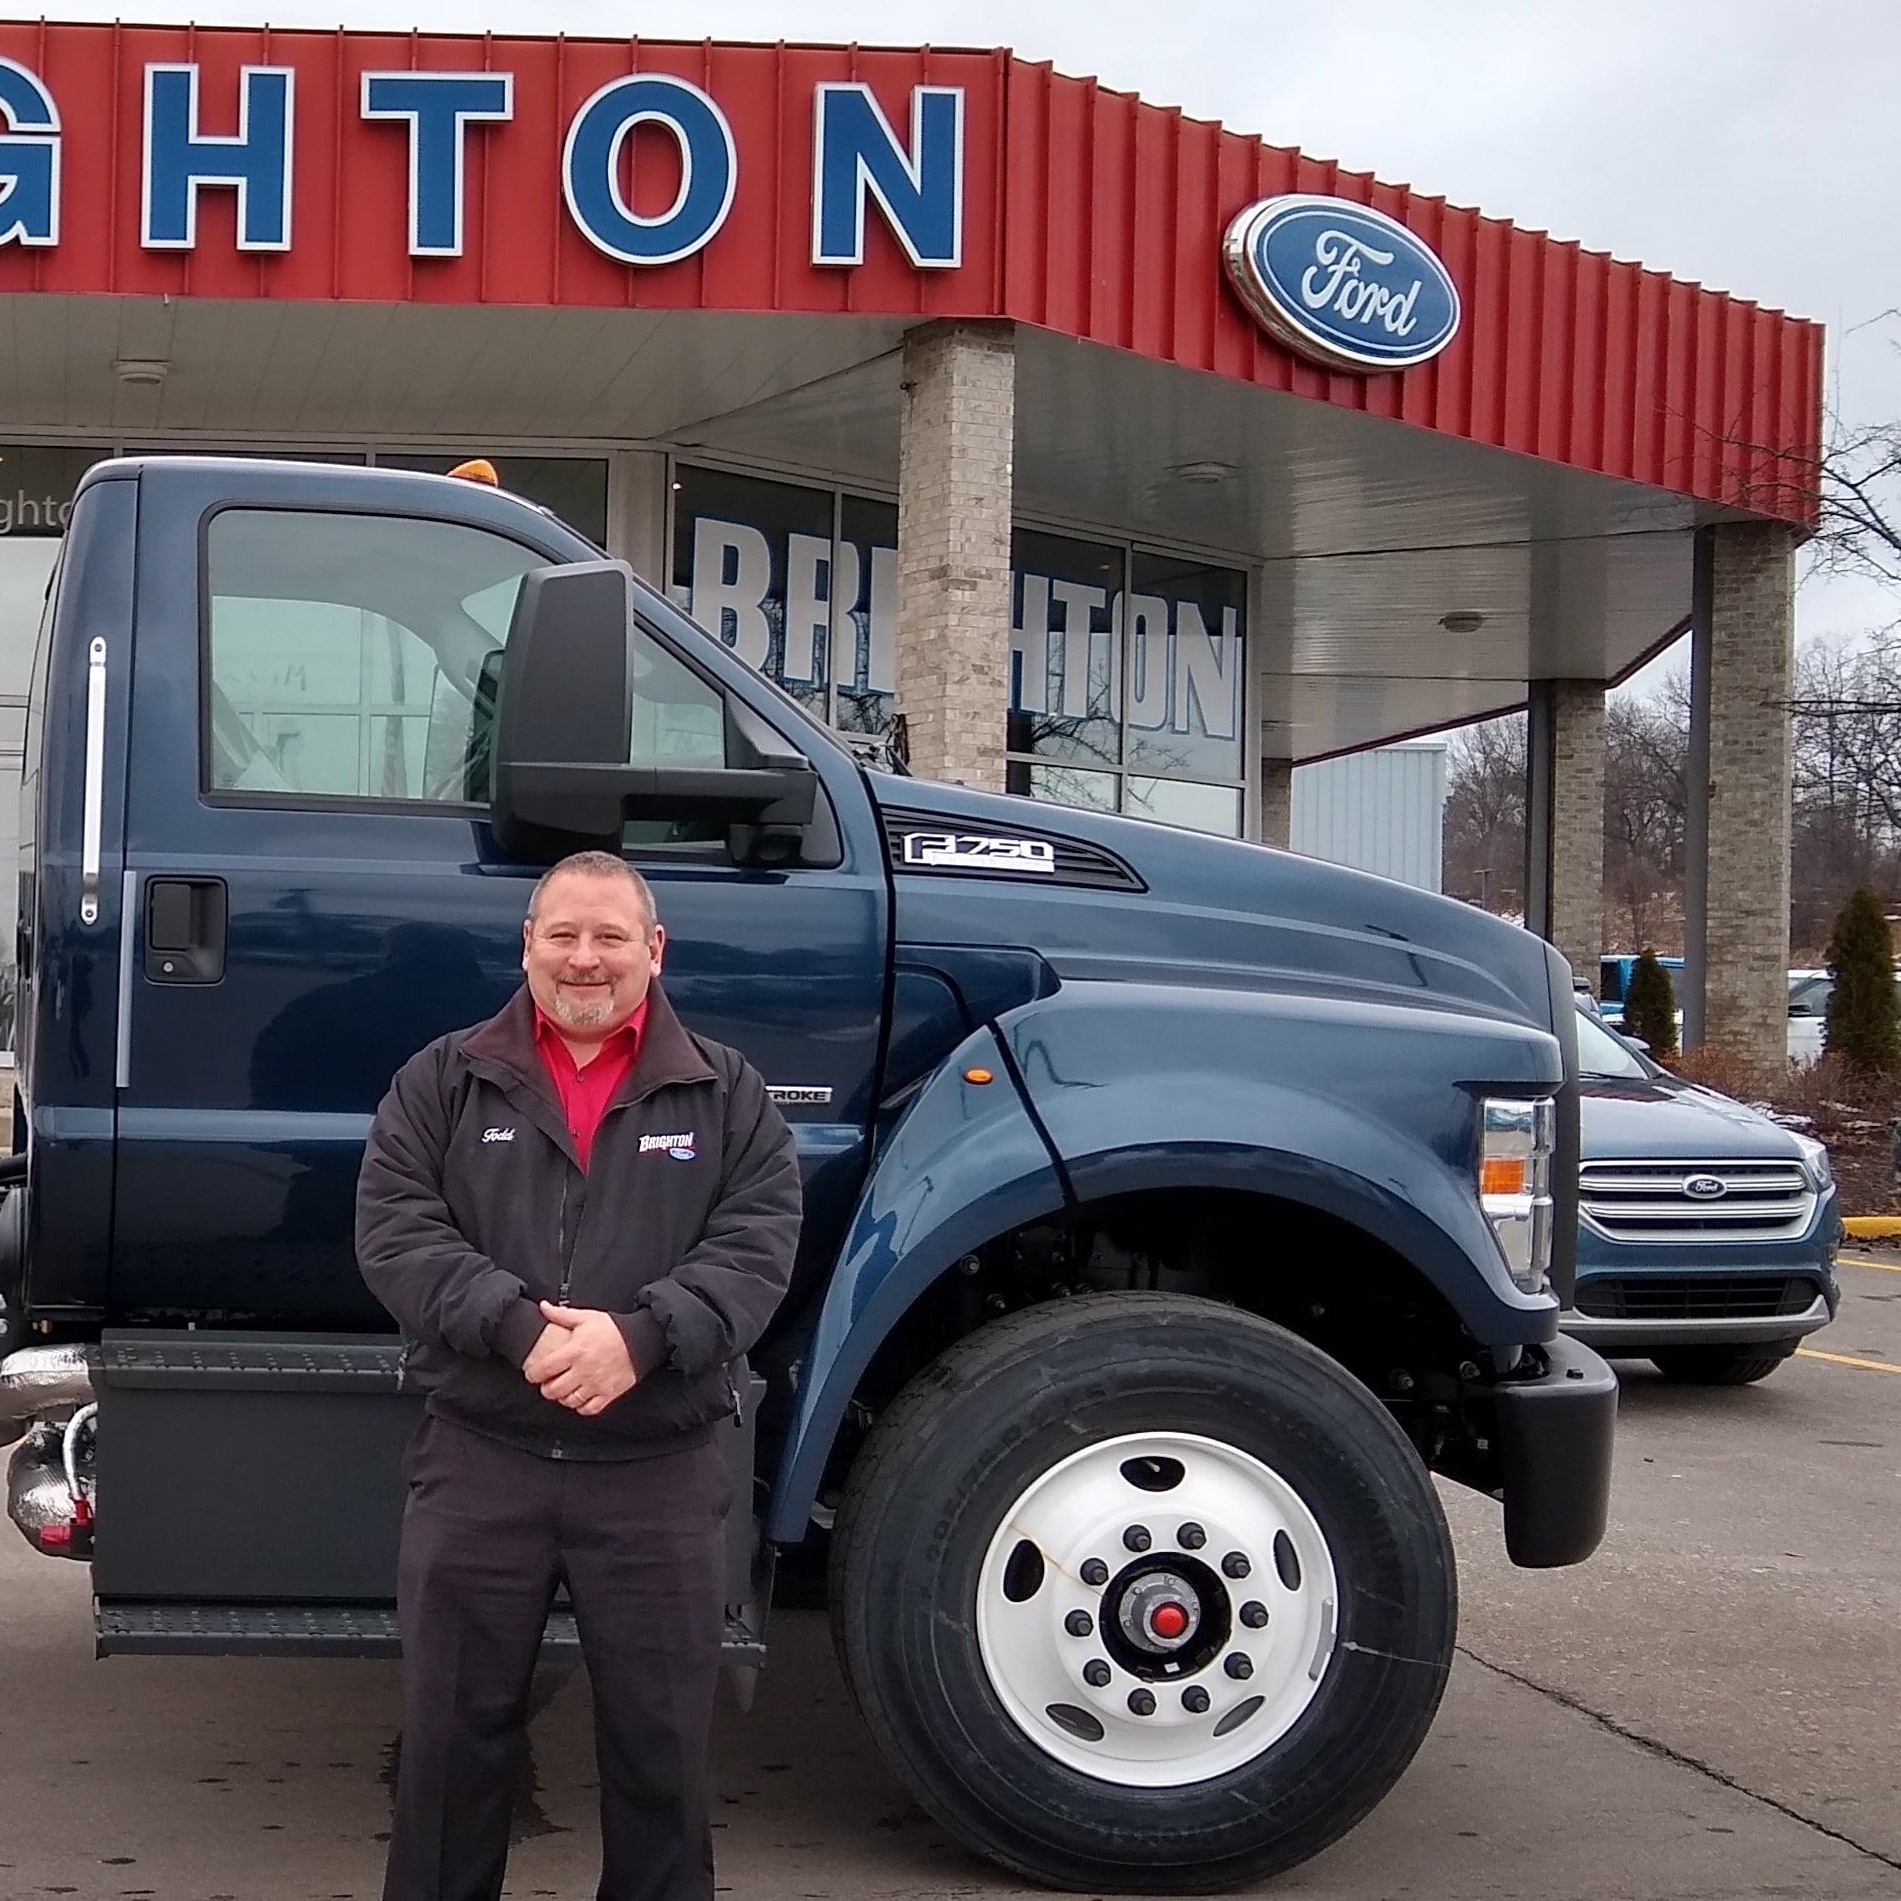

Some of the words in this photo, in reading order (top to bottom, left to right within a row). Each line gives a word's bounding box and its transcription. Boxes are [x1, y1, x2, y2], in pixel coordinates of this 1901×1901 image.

[1301, 230, 1422, 336] Ford
[770, 1090, 827, 1101] ROKE
[481, 1127, 516, 1143] Todd
[1694, 1180, 1719, 1192] Ford
